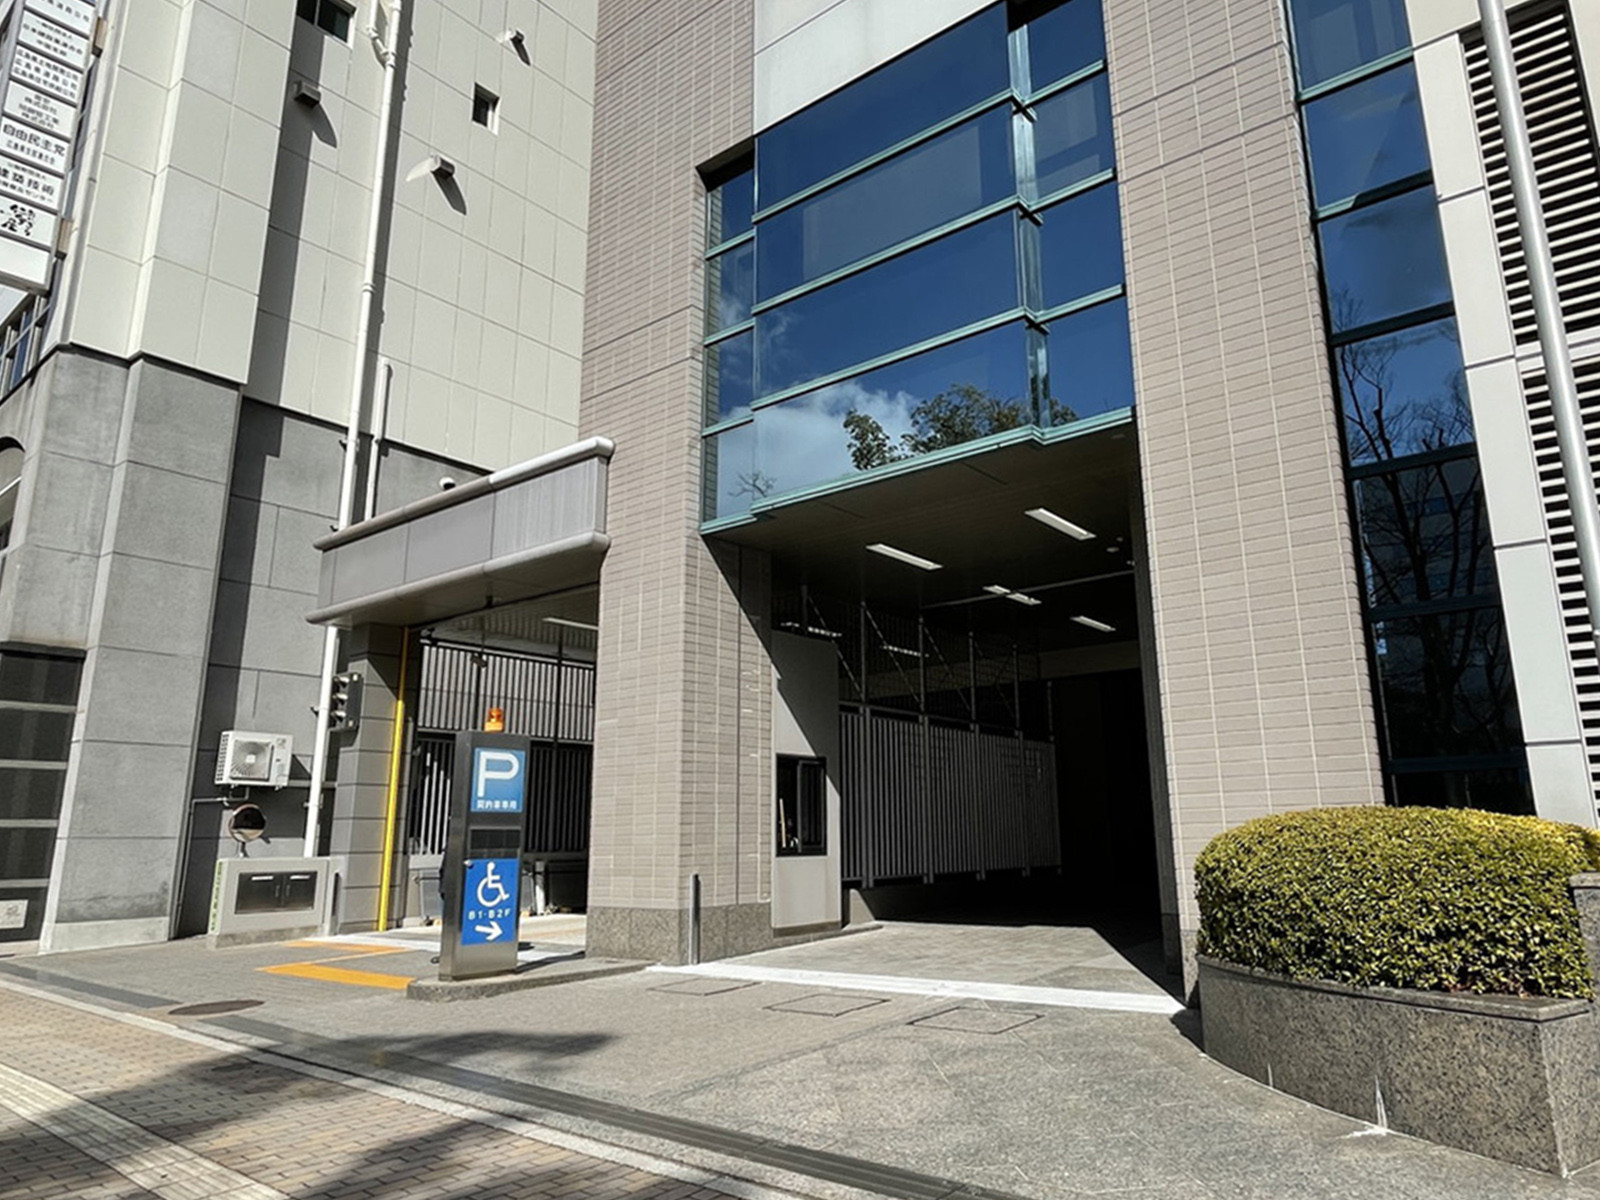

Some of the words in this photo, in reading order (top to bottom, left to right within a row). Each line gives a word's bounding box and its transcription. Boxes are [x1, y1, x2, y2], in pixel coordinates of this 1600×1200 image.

[3, 123, 66, 157] 自由民主党
[0, 166, 54, 196] 建築技術
[477, 751, 520, 798] P
